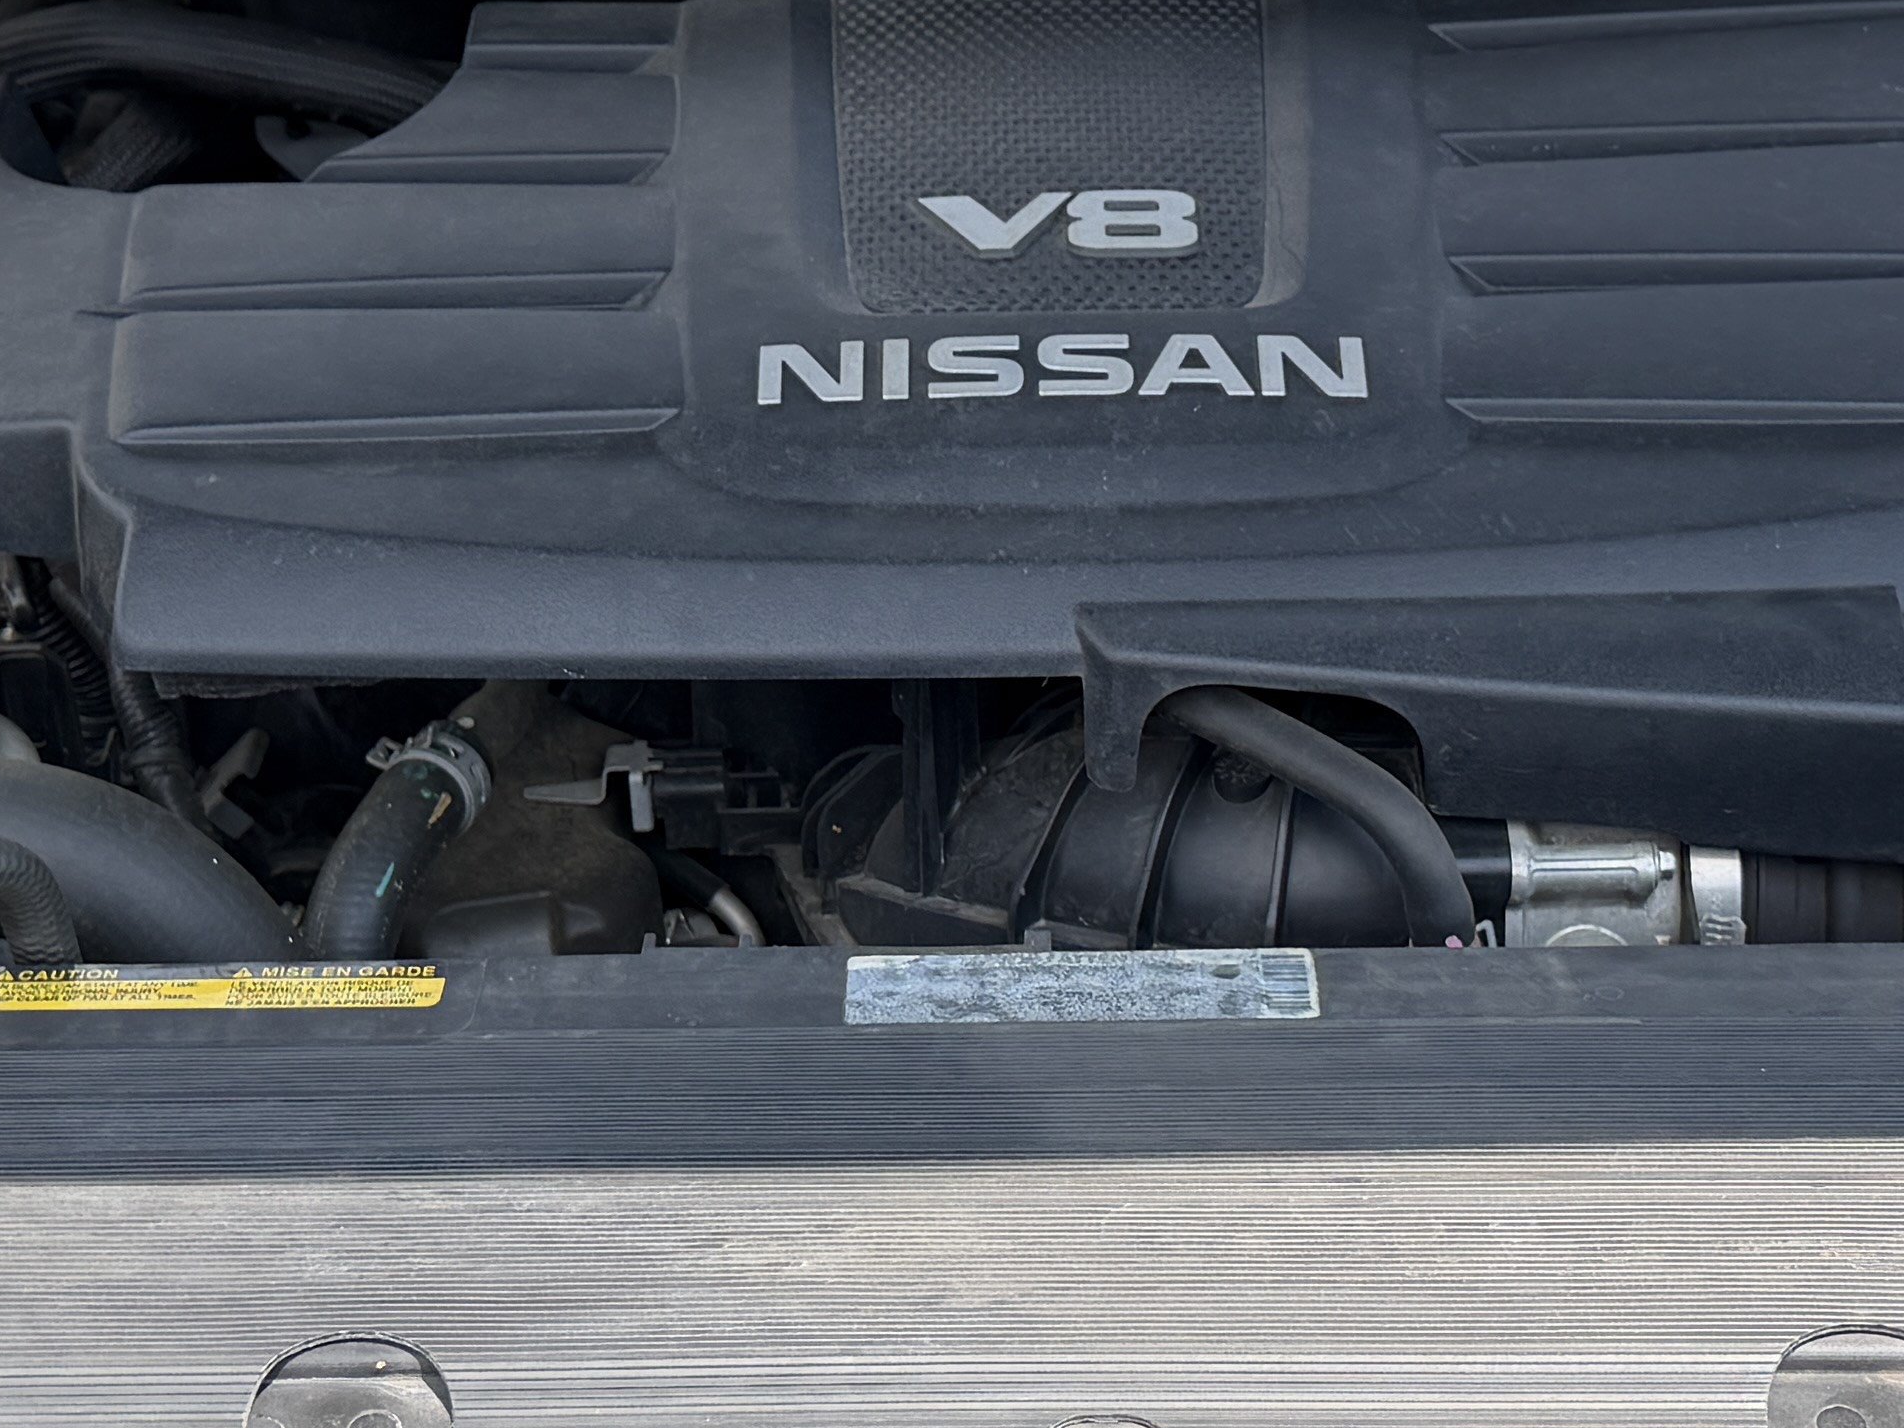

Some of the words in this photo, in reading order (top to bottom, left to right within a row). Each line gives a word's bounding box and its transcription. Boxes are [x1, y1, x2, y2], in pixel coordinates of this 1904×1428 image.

[917, 187, 1200, 259] V8
[756, 333, 1371, 405] NISSAN
[18, 968, 119, 981] CAUTION
[261, 965, 315, 978] MISE
[321, 966, 352, 977] EN
[357, 965, 437, 978] GARDE
